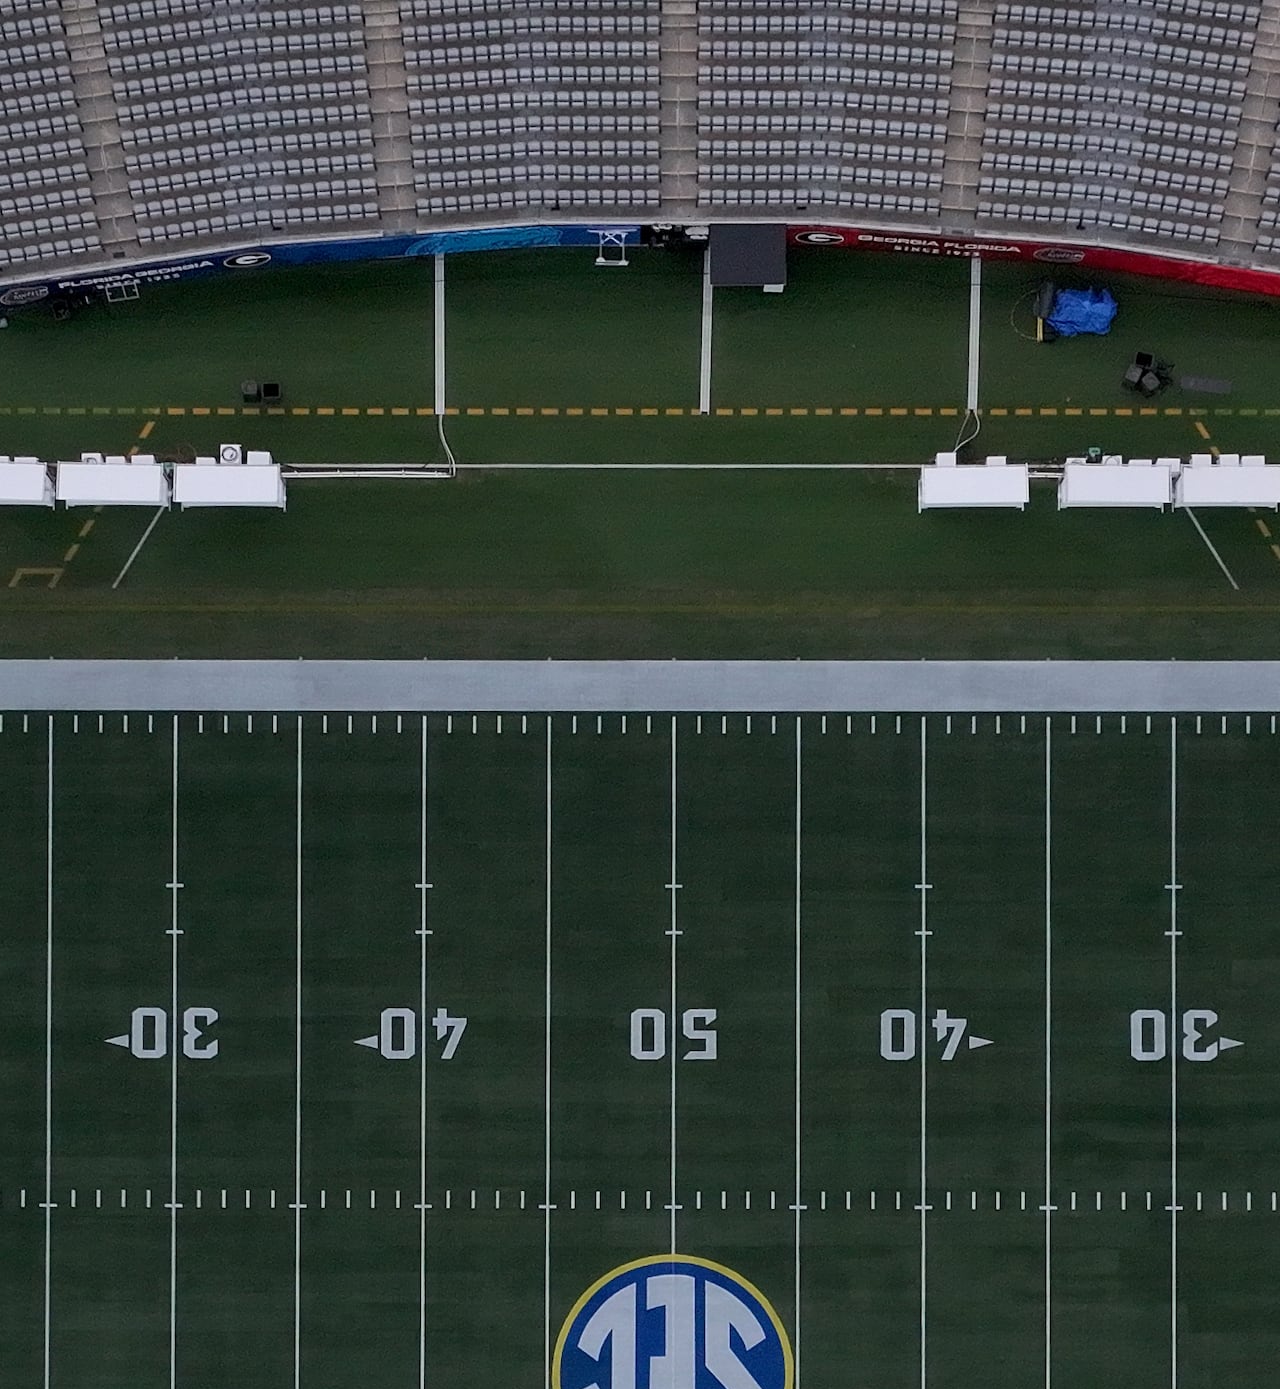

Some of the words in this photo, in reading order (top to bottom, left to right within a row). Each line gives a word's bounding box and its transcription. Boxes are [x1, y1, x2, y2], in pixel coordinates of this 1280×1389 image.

[858, 234, 939, 247] GEORGIA
[944, 241, 1021, 253] FLORIDA
[58, 273, 134, 289] FLORIDA
[135, 259, 214, 278] GEORGIA
[132, 1007, 219, 1059] 30
[381, 1008, 468, 1060] 40
[631, 1009, 717, 1060] 50
[881, 1009, 967, 1061] 40
[1131, 1010, 1218, 1062] 30
